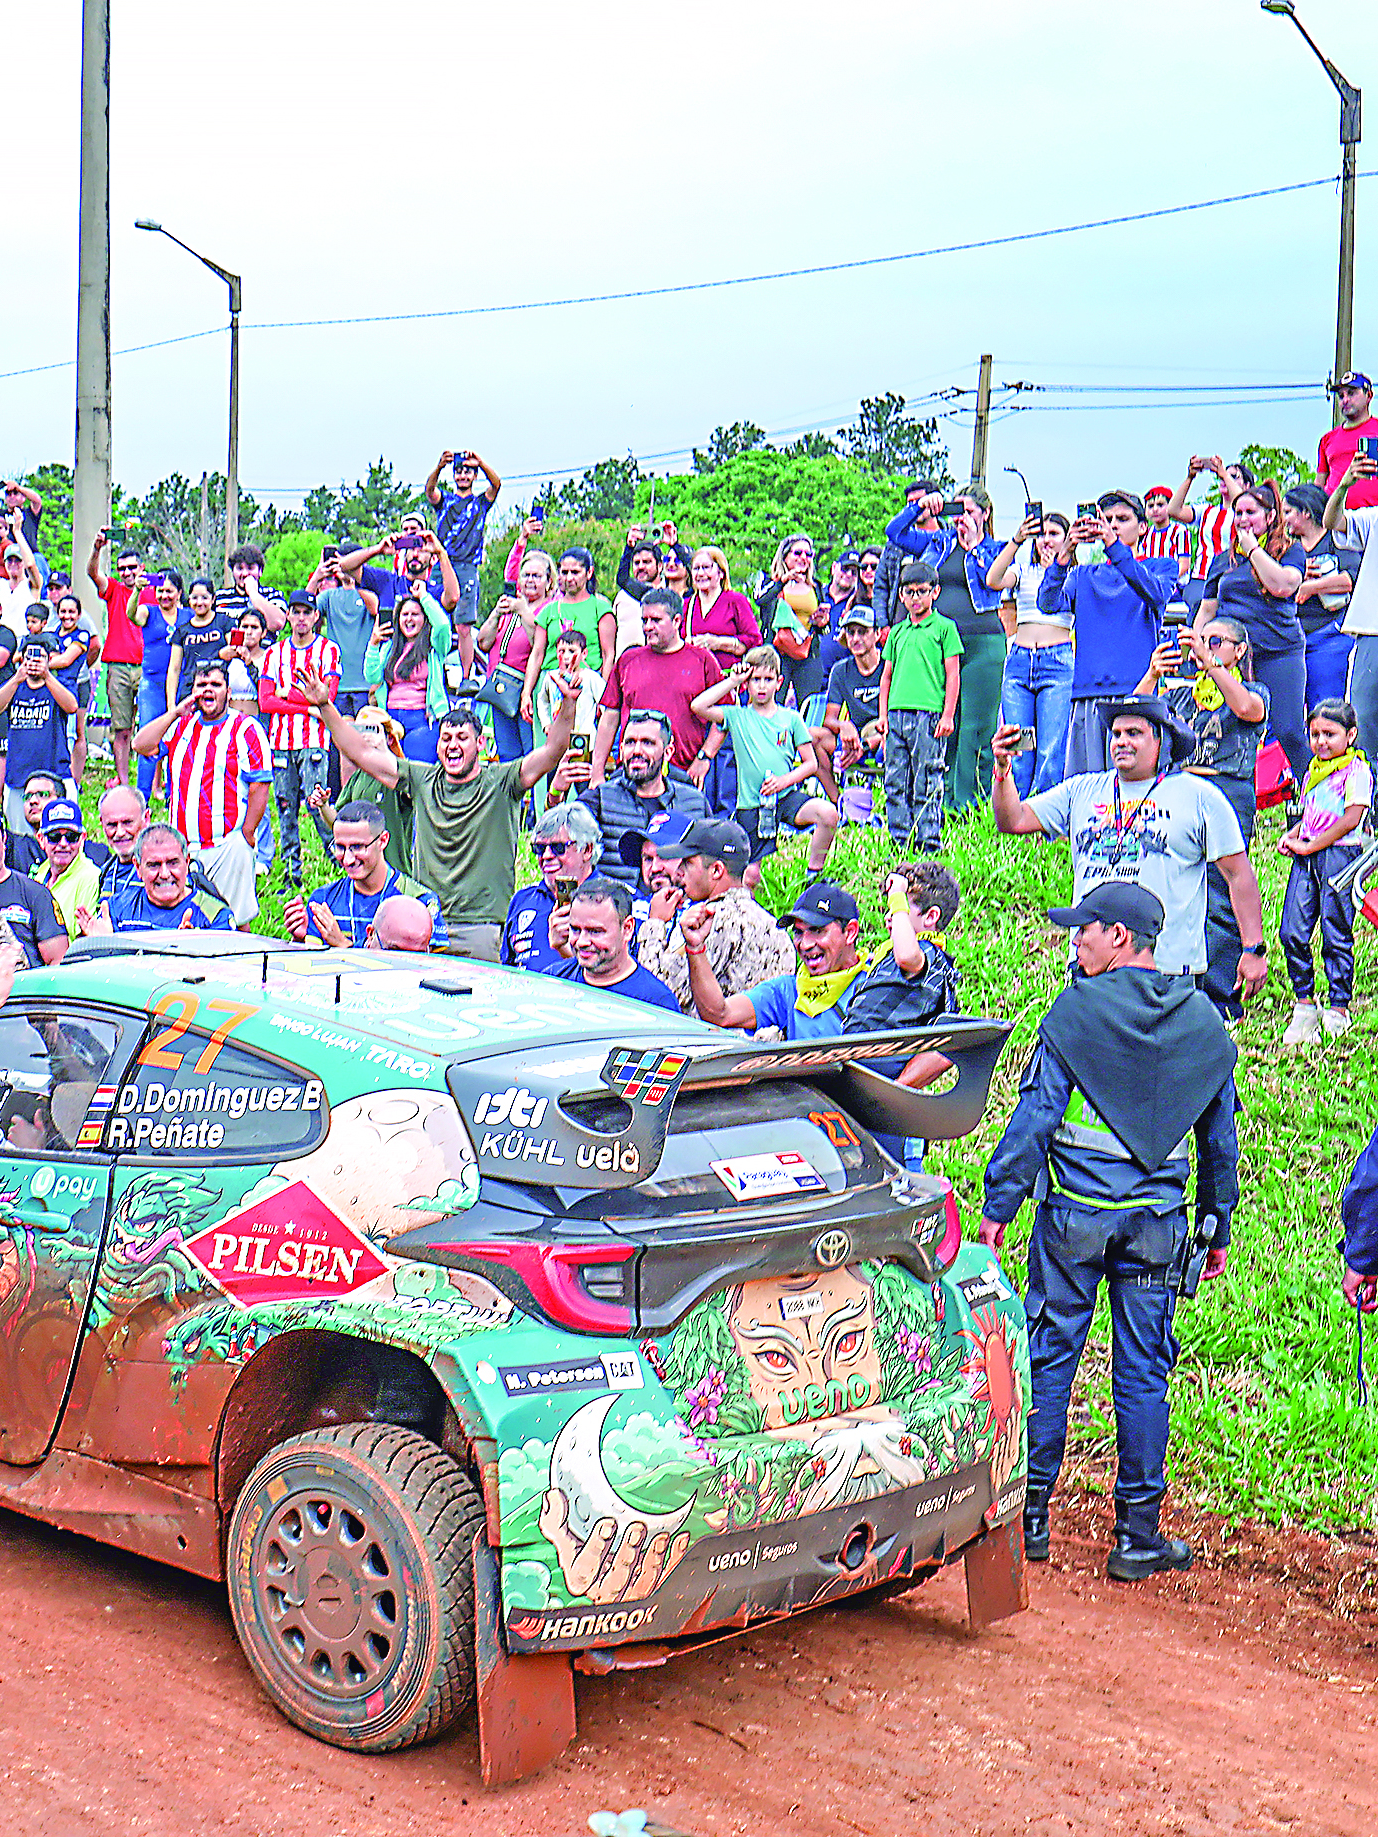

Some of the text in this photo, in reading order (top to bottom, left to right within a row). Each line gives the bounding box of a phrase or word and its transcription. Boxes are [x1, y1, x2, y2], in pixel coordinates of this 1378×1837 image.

[137, 991, 263, 1076] 27
[301, 1079, 325, 1112] B
[107, 1116, 226, 1149] R.Peñate
[808, 1110, 862, 1148] 27
[479, 1129, 566, 1167] KÜHL
[251, 1222, 329, 1242] DESDE 1912
[207, 1232, 364, 1285] PILSEN
[527, 1365, 606, 1388] Petersen
[610, 1361, 636, 1379] CAT
[777, 1373, 871, 1425] ueno
[914, 1494, 947, 1518] ueno
[707, 1540, 799, 1573] ueno Seguros
